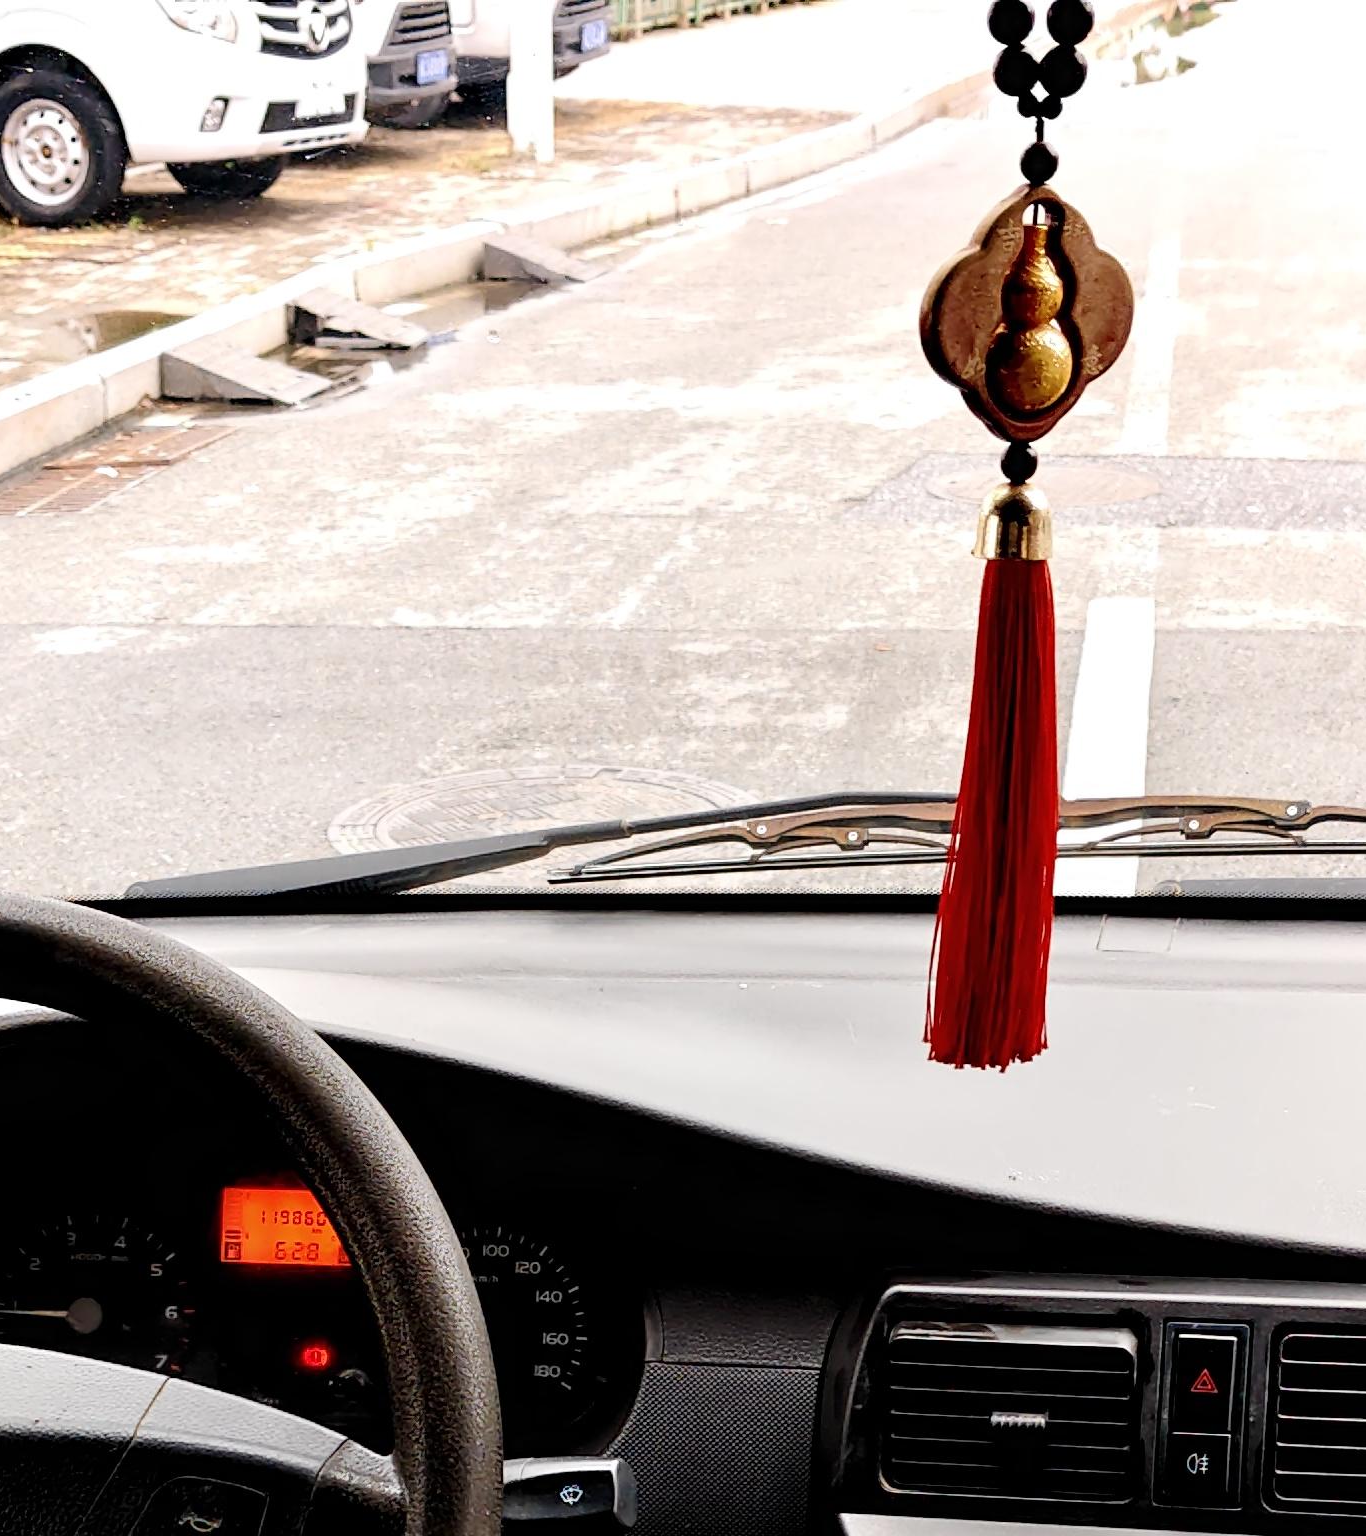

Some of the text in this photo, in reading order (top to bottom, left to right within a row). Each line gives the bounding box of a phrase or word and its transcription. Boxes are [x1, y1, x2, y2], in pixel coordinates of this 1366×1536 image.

[114, 1235, 127, 1248] 4
[274, 1241, 320, 1261] 628
[482, 1244, 510, 1257] 100
[29, 1257, 42, 1271] 2
[150, 1263, 163, 1277] 5
[515, 1261, 541, 1274] 120
[535, 1290, 563, 1304] 140
[164, 1305, 178, 1319] 6
[542, 1332, 569, 1346] 160
[154, 1354, 168, 1369] 7
[533, 1364, 561, 1378] 180
